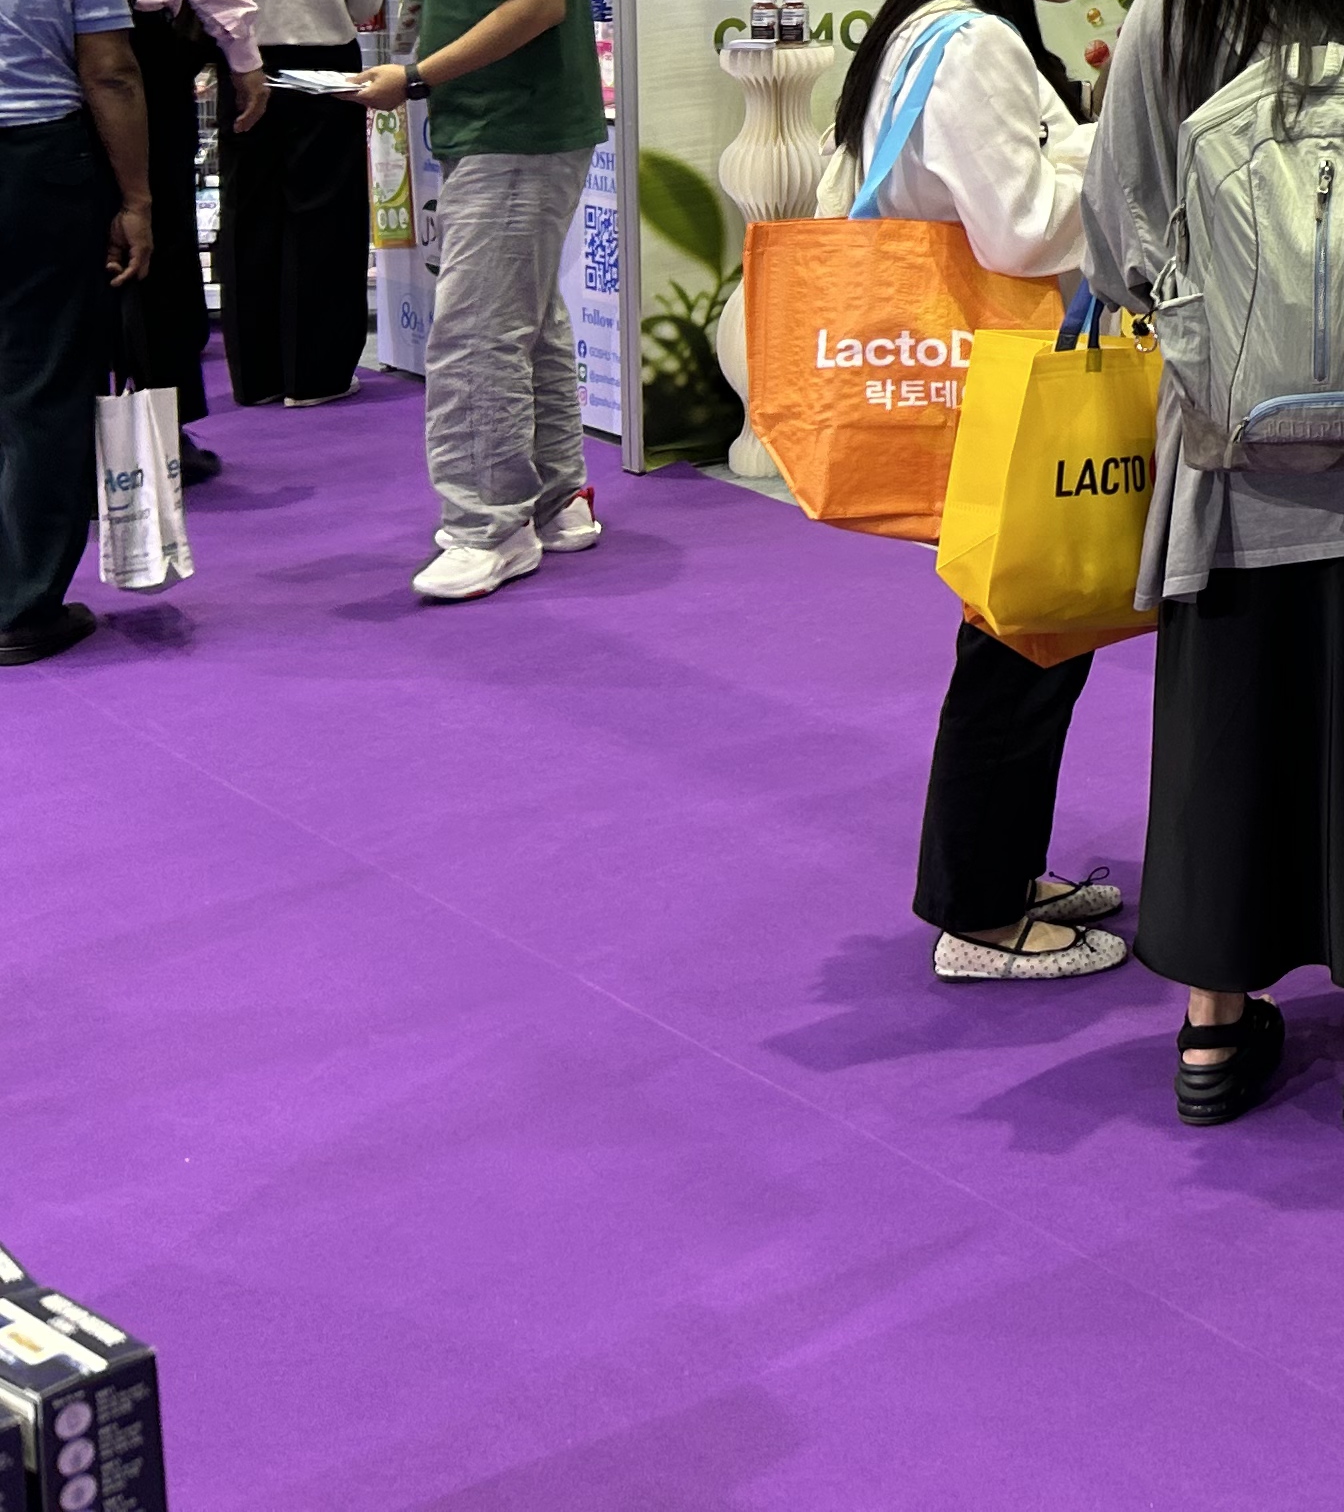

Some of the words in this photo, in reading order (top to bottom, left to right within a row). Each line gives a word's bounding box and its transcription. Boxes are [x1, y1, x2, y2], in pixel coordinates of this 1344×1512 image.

[582, 308, 610, 329] Follow
[865, 377, 968, 410] 락토데
[1055, 455, 1147, 498] LACTO
